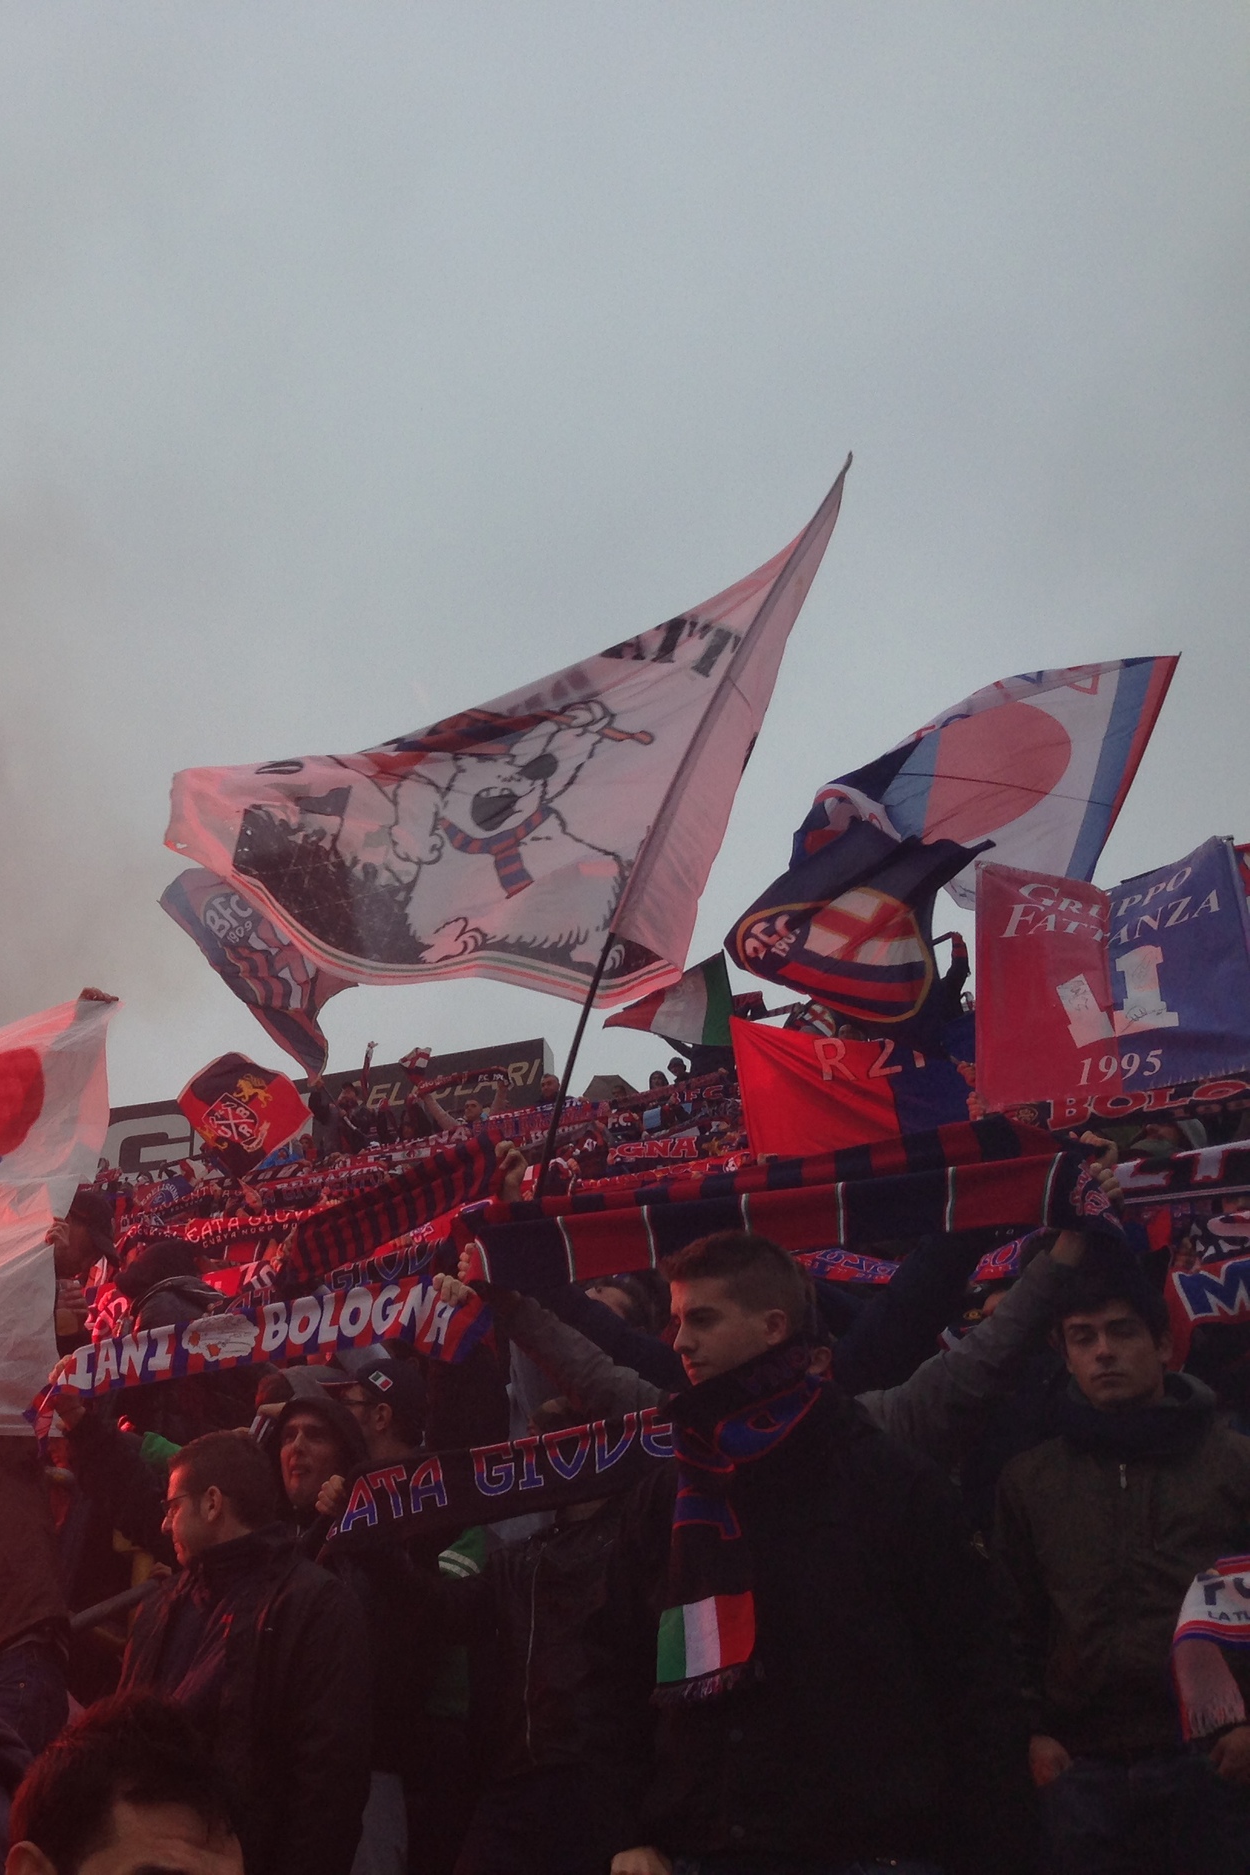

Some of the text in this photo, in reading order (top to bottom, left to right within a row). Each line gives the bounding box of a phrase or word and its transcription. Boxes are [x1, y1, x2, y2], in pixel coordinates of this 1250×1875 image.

[205, 893, 254, 940] BFC
[999, 889, 1221, 949] FATTANZA
[1018, 866, 1192, 923] GRUPPO
[1076, 1048, 1164, 1087] 1995
[57, 1286, 455, 1391] IANI BOLOGNA
[326, 1455, 448, 1539] ATA
